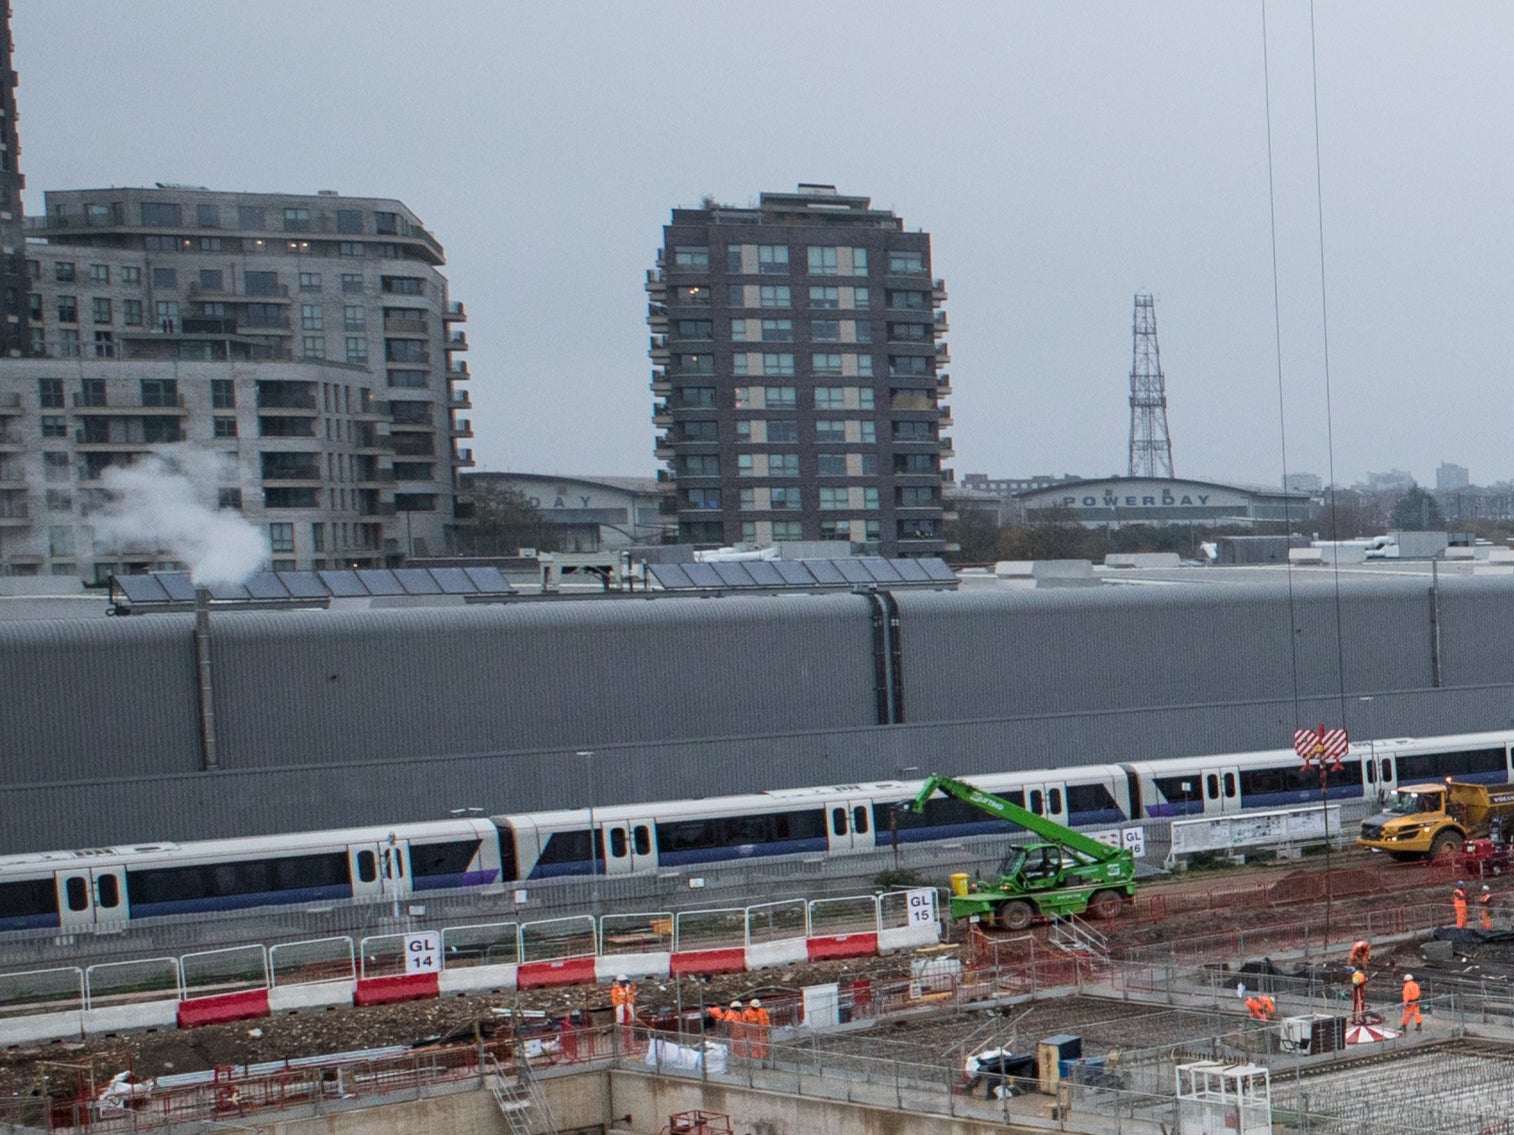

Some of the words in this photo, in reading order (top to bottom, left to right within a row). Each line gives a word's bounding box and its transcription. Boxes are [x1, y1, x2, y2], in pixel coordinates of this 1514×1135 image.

[1062, 495, 1210, 507] POWERDAY
[1126, 832, 1141, 841] GL
[910, 896, 930, 907] GL
[914, 910, 929, 921] 15
[410, 940, 435, 952] GL
[413, 956, 432, 968] 14
